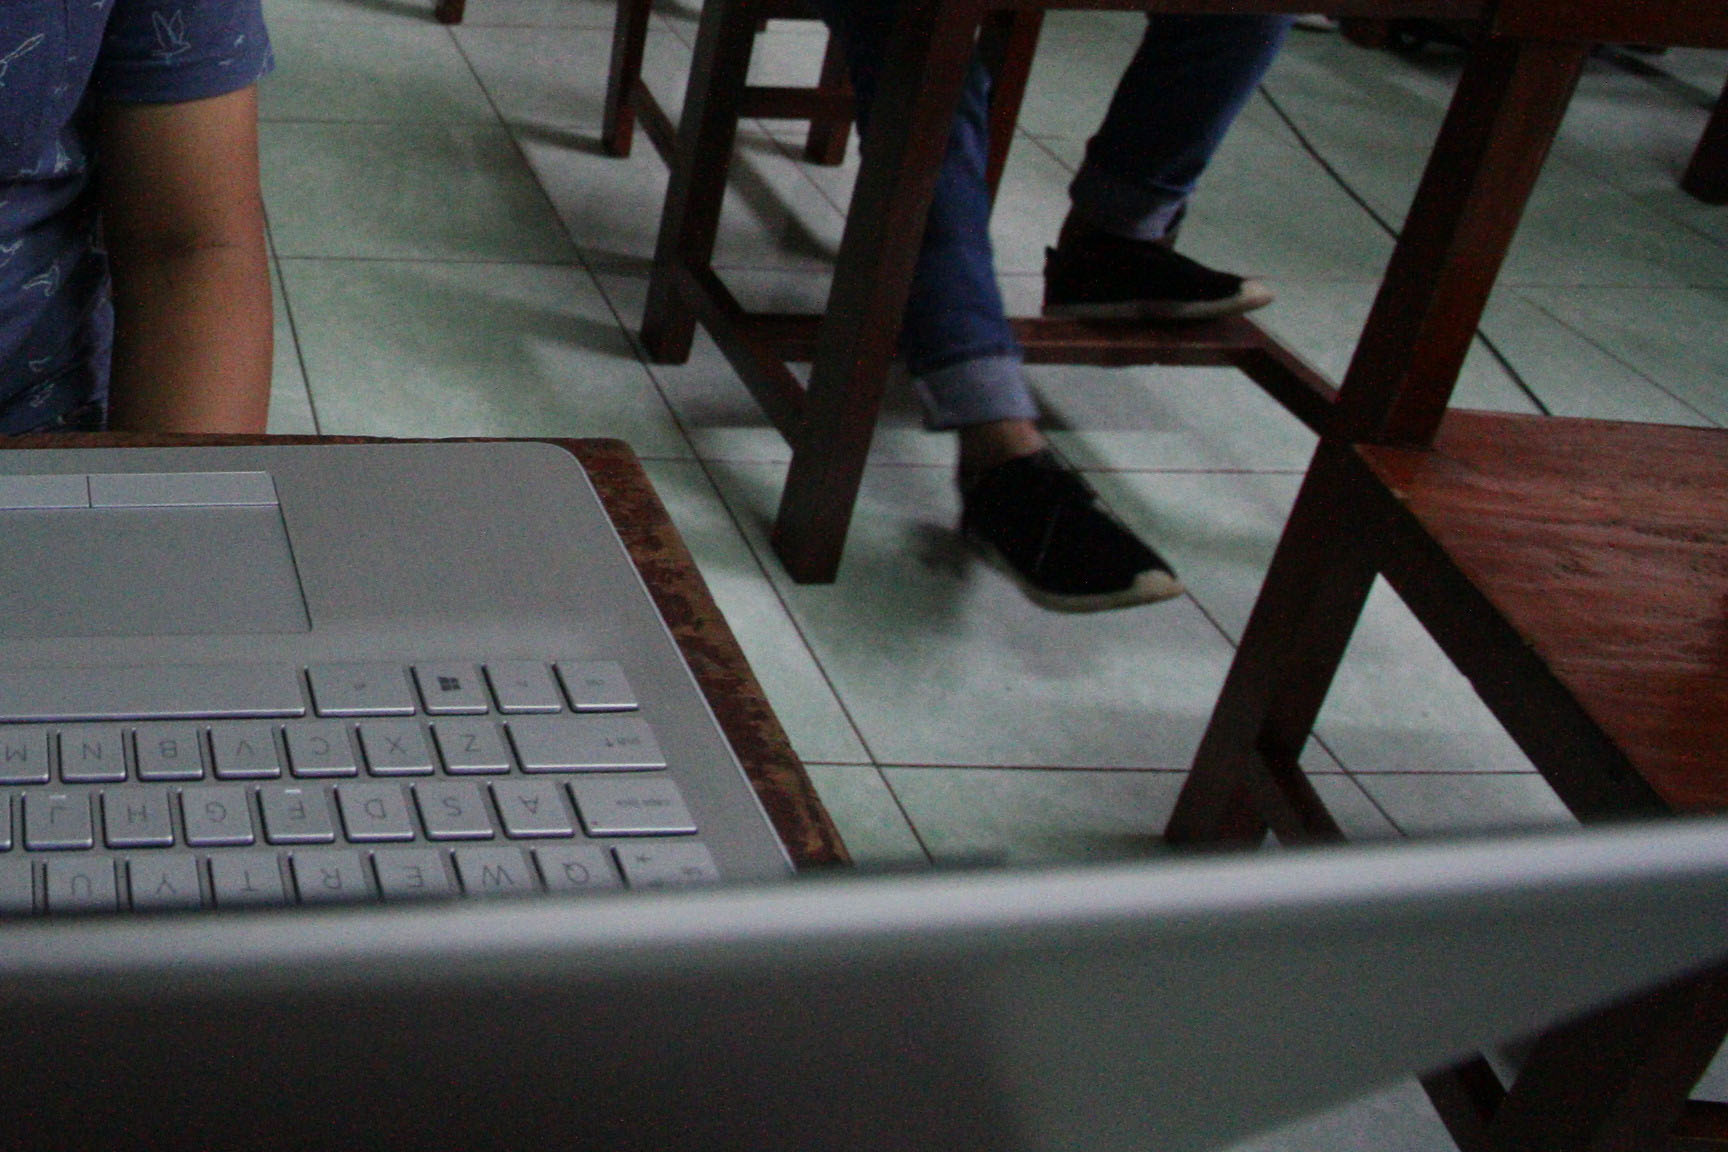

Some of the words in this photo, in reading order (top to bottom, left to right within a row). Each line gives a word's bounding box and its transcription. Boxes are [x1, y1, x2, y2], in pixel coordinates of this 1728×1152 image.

[82, 743, 101, 760] N
[160, 740, 178, 758] B
[236, 740, 254, 756] V
[311, 737, 330, 755] C
[384, 737, 406, 754] X
[460, 734, 480, 752] Z
[5, 746, 27, 762] M
[126, 804, 147, 824] H
[205, 802, 226, 822] G
[289, 800, 306, 821] F
[364, 799, 386, 820] D
[442, 797, 462, 817] S
[518, 796, 539, 814] A
[50, 807, 66, 825] J
[239, 870, 261, 892] T
[321, 868, 341, 889] R
[402, 866, 424, 888] E
[482, 864, 515, 886] W
[562, 862, 590, 884] Q
[70, 874, 92, 896] U
[154, 873, 175, 895] Y
